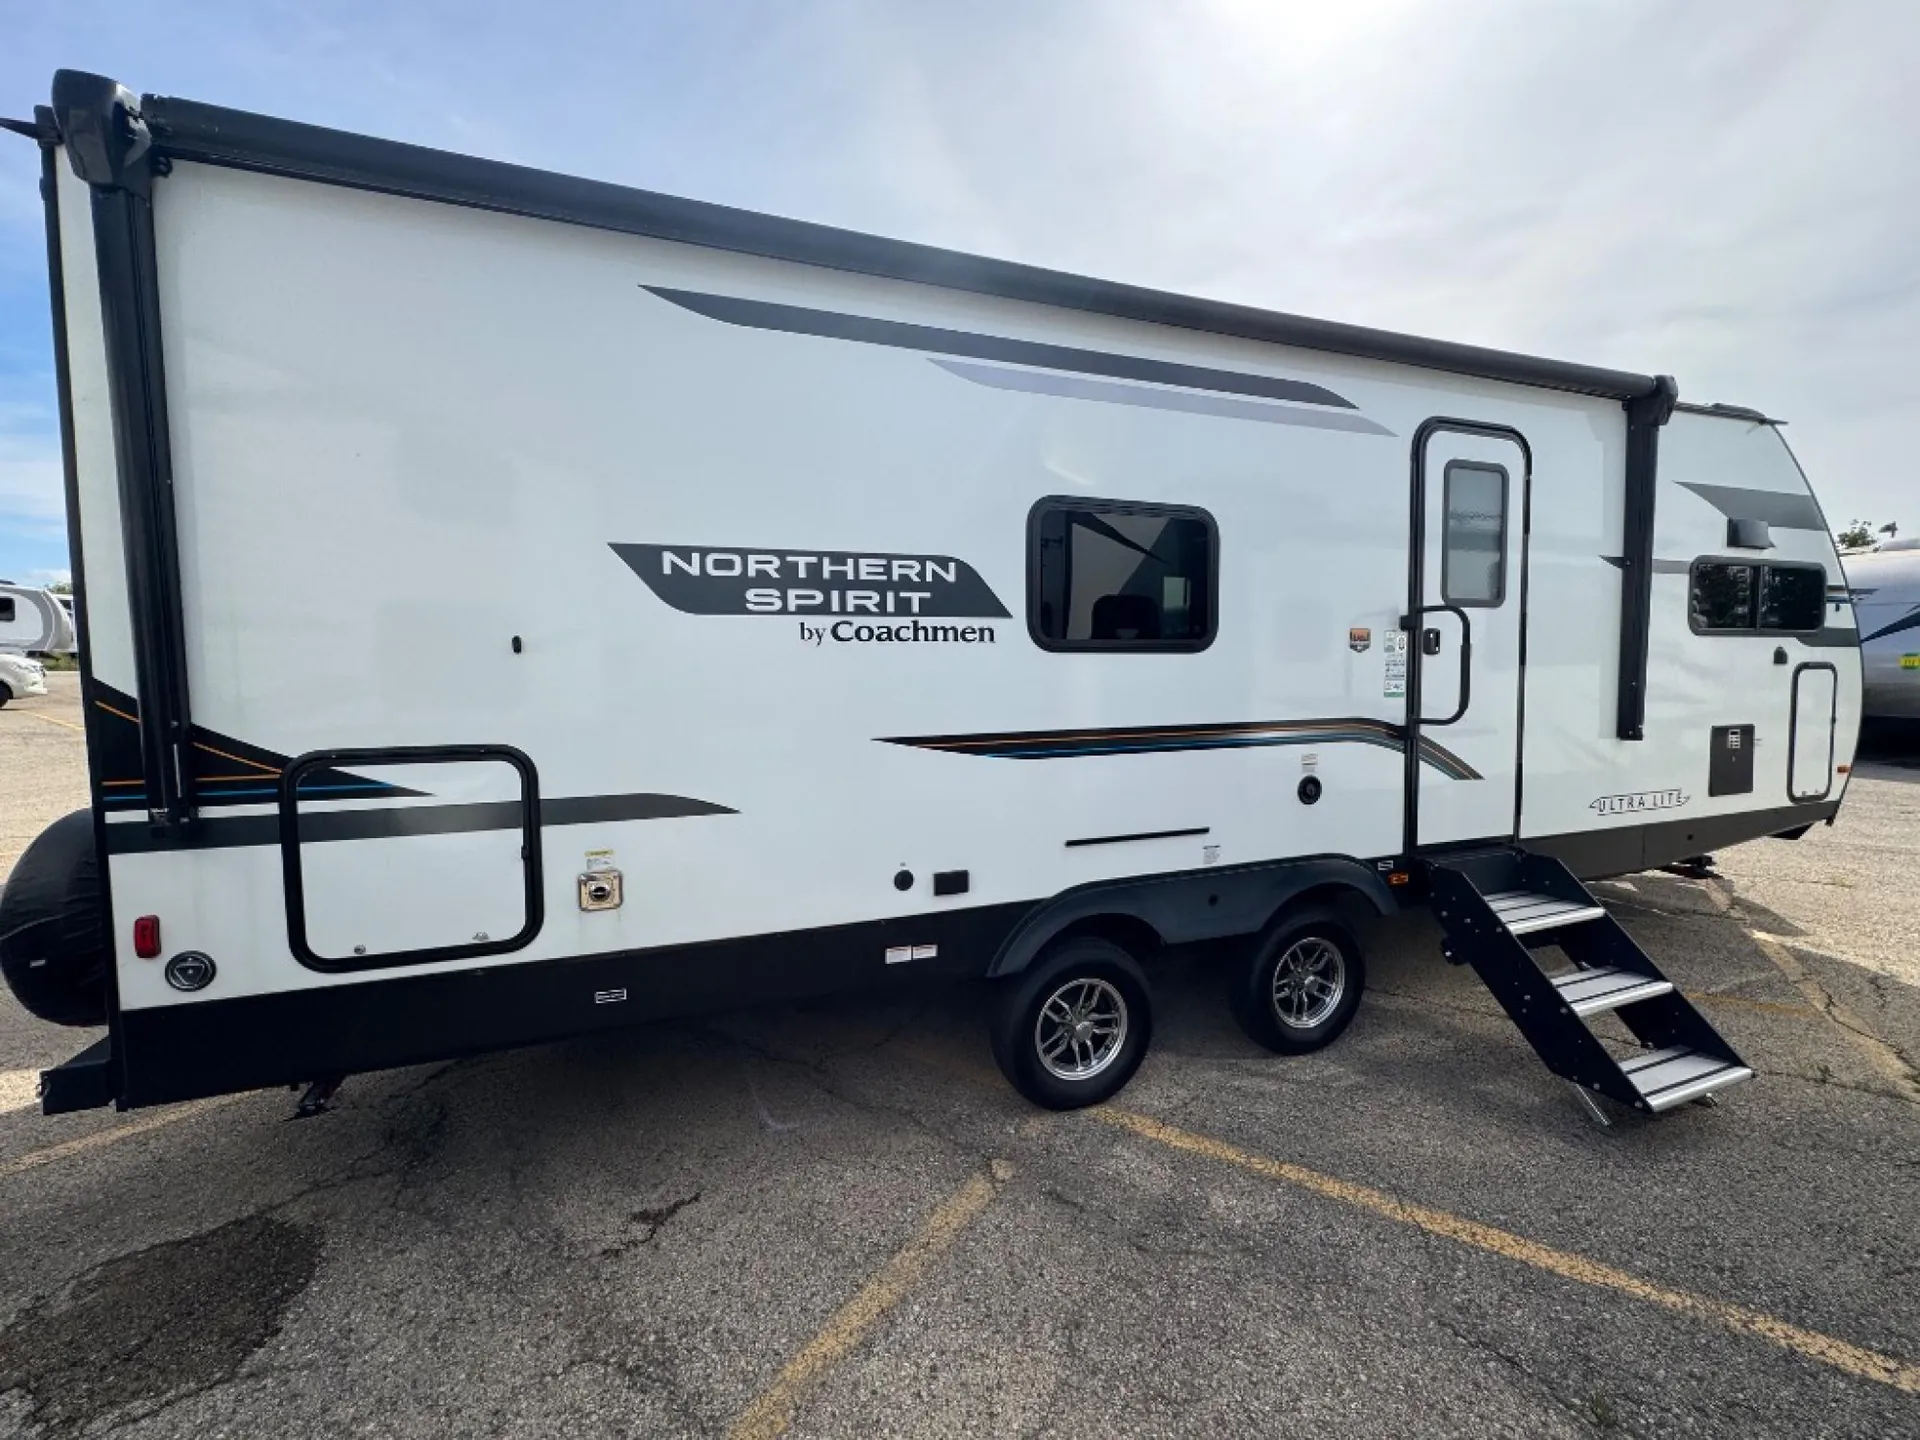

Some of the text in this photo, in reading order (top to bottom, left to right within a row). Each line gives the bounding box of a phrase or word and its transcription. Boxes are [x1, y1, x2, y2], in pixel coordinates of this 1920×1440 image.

[661, 551, 957, 583] NORTHERN
[745, 588, 932, 614] SPIRIT
[800, 619, 997, 646] by Coachmen
[1599, 792, 1682, 812] ULTRA LITE
